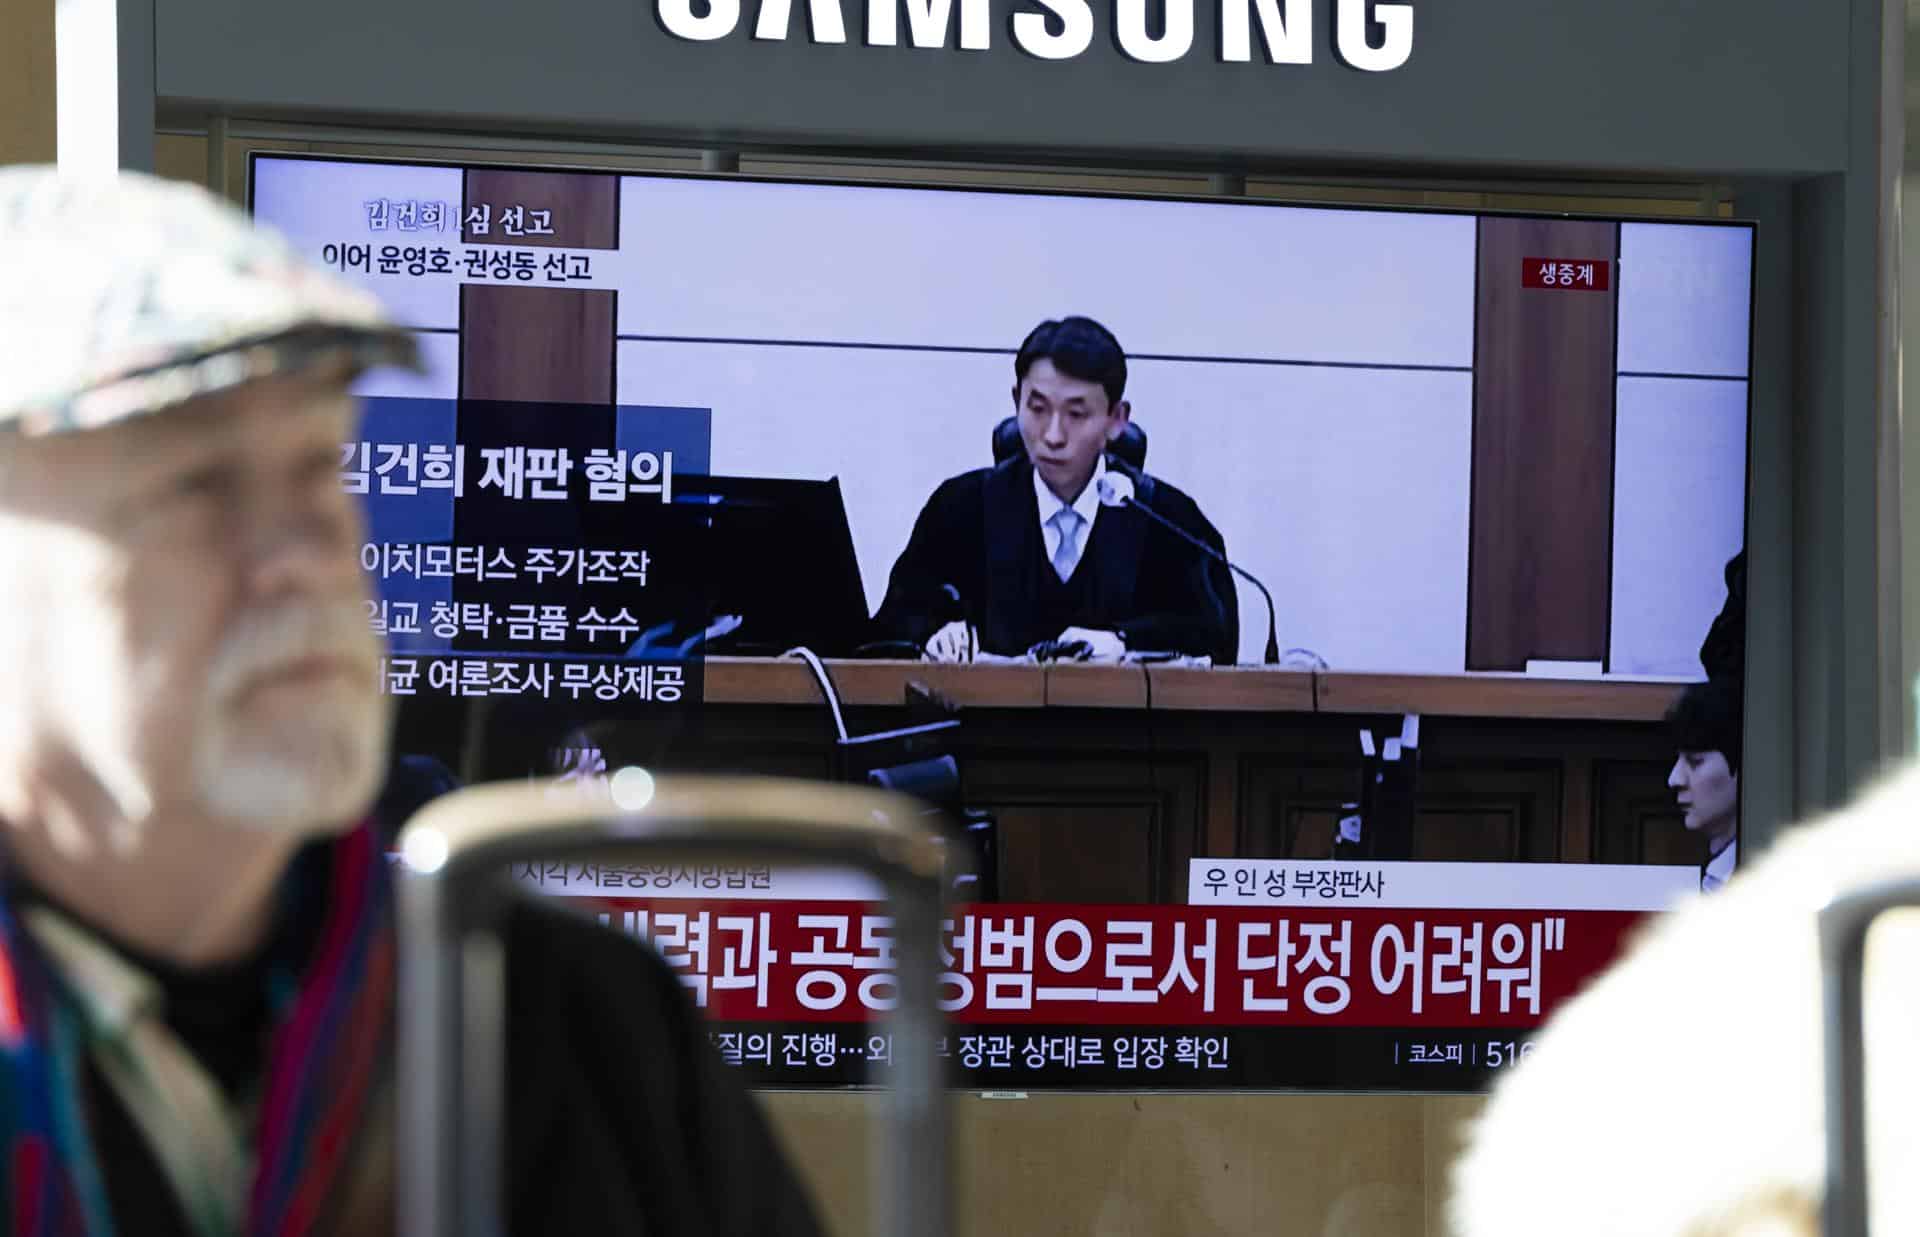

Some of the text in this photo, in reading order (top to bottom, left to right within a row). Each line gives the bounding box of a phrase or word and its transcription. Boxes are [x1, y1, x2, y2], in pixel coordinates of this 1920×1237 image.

[365, 200, 446, 233] 김건희
[499, 206, 554, 236] 선고
[322, 243, 371, 273] 이어
[543, 252, 592, 282] 선고
[1539, 262, 1594, 286] 생중계
[338, 441, 672, 504] 김건희 재판 혐의
[524, 548, 650, 586] 주가조작
[576, 606, 640, 643] 수수
[377, 658, 685, 702] 균 여론조사 무상제공
[1292, 870, 1385, 899] 부장판사
[598, 910, 778, 1008] 력과
[1237, 919, 1352, 1015] 단정
[1370, 918, 1566, 1015] 어려워"
[709, 1032, 772, 1066] 질의
[958, 1035, 1015, 1068] 장관
[1021, 1036, 1105, 1069] 상대로
[1113, 1036, 1168, 1069] 입장
[1174, 1036, 1228, 1069] 확인
[1409, 1043, 1463, 1065] 코스피
